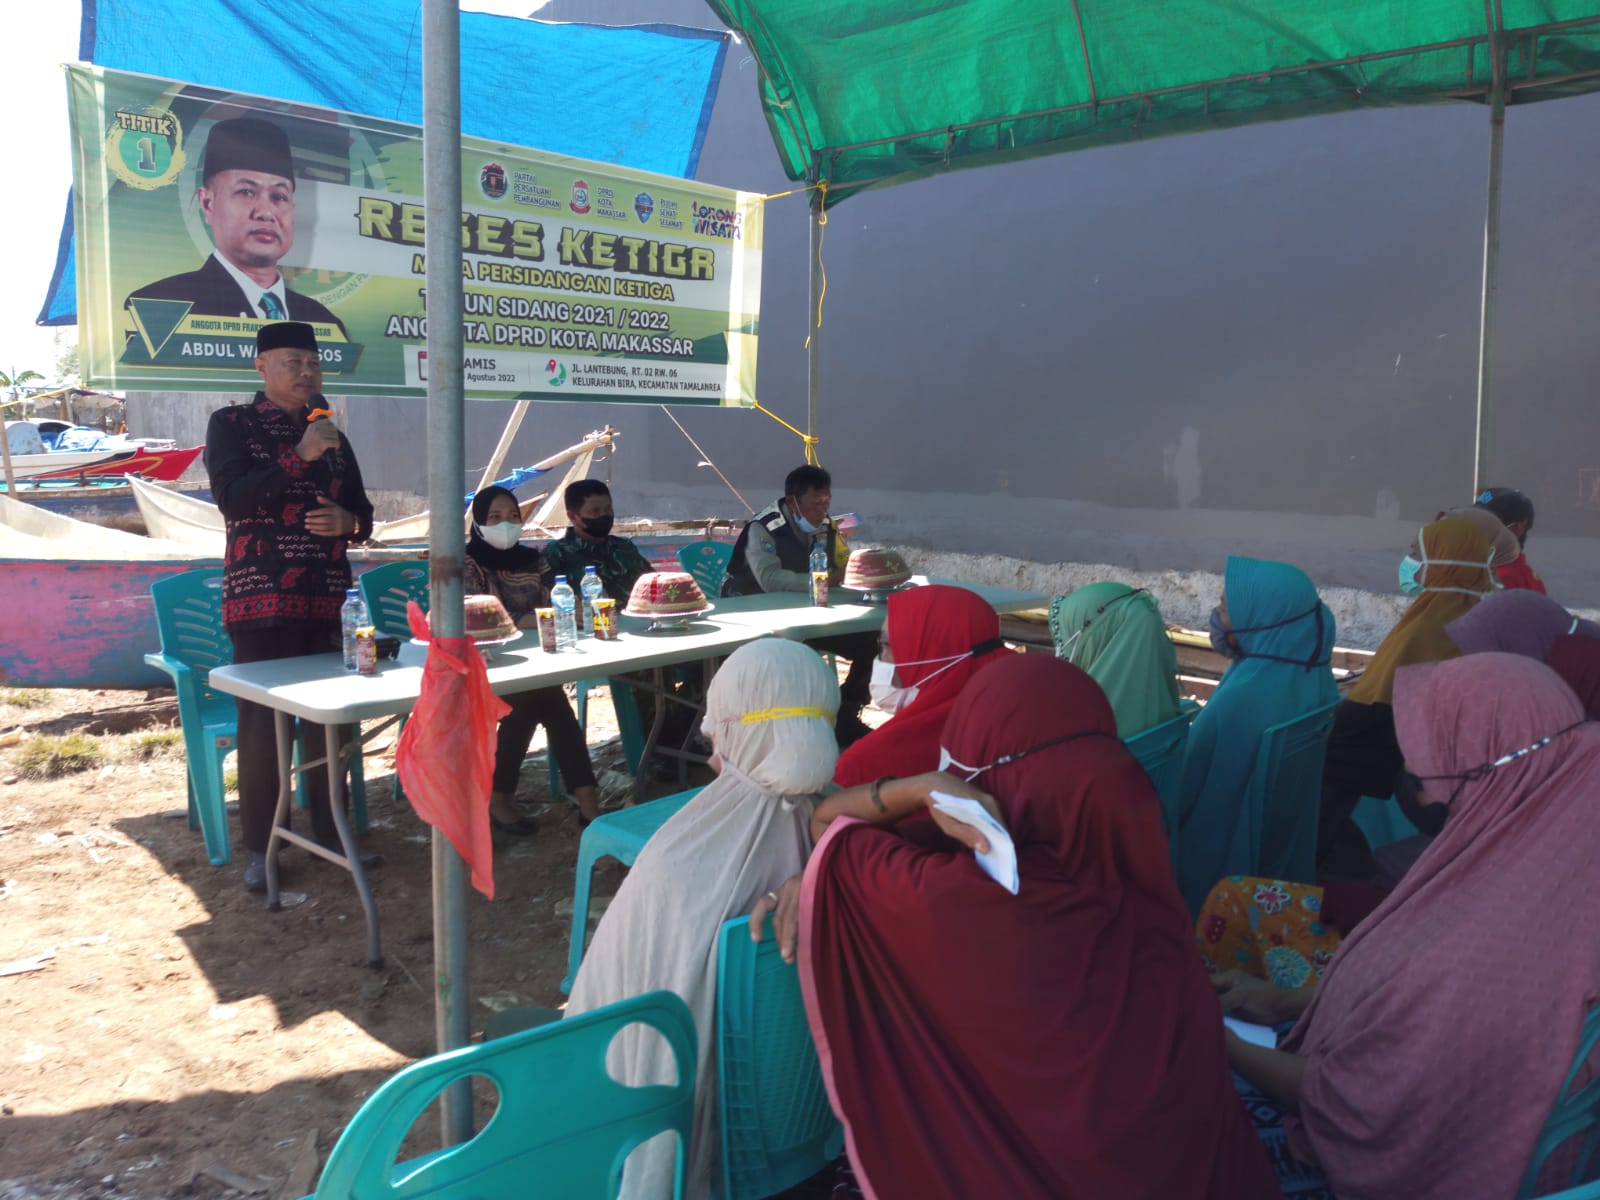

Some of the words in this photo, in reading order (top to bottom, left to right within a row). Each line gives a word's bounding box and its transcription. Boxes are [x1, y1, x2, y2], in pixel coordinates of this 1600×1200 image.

[115, 111, 172, 136] TITIK
[137, 137, 156, 172] 1
[692, 200, 742, 224] LORONG
[692, 218, 741, 240] WISATA
[557, 226, 714, 280] KETIGA
[478, 261, 611, 294] PERSIDANGAN
[614, 278, 674, 301] KETIGA
[191, 320, 221, 330] ANGGOTA
[498, 297, 569, 323] SIDANG
[573, 304, 614, 327] 2021
[618, 309, 627, 329] /
[630, 310, 669, 331] 2022
[181, 342, 235, 358] ABDUL
[494, 322, 546, 347] DPRD
[550, 328, 598, 350] KOTA
[602, 332, 694, 356] MAKASSAR
[463, 358, 496, 370] AMIS
[572, 363, 582, 373] JL.
[584, 365, 628, 377] LANTEBUNG,
[632, 367, 643, 376] RT.
[645, 368, 653, 376] 02
[655, 368, 668, 377] RW.
[669, 369, 677, 378] 06
[467, 373, 496, 383] Agustus
[498, 374, 515, 382] 2022
[573, 377, 616, 388] KELURAHAN
[618, 379, 637, 390] BIRA,
[638, 380, 678, 390] KECAMATAN
[680, 382, 721, 391] TAMALANREA
